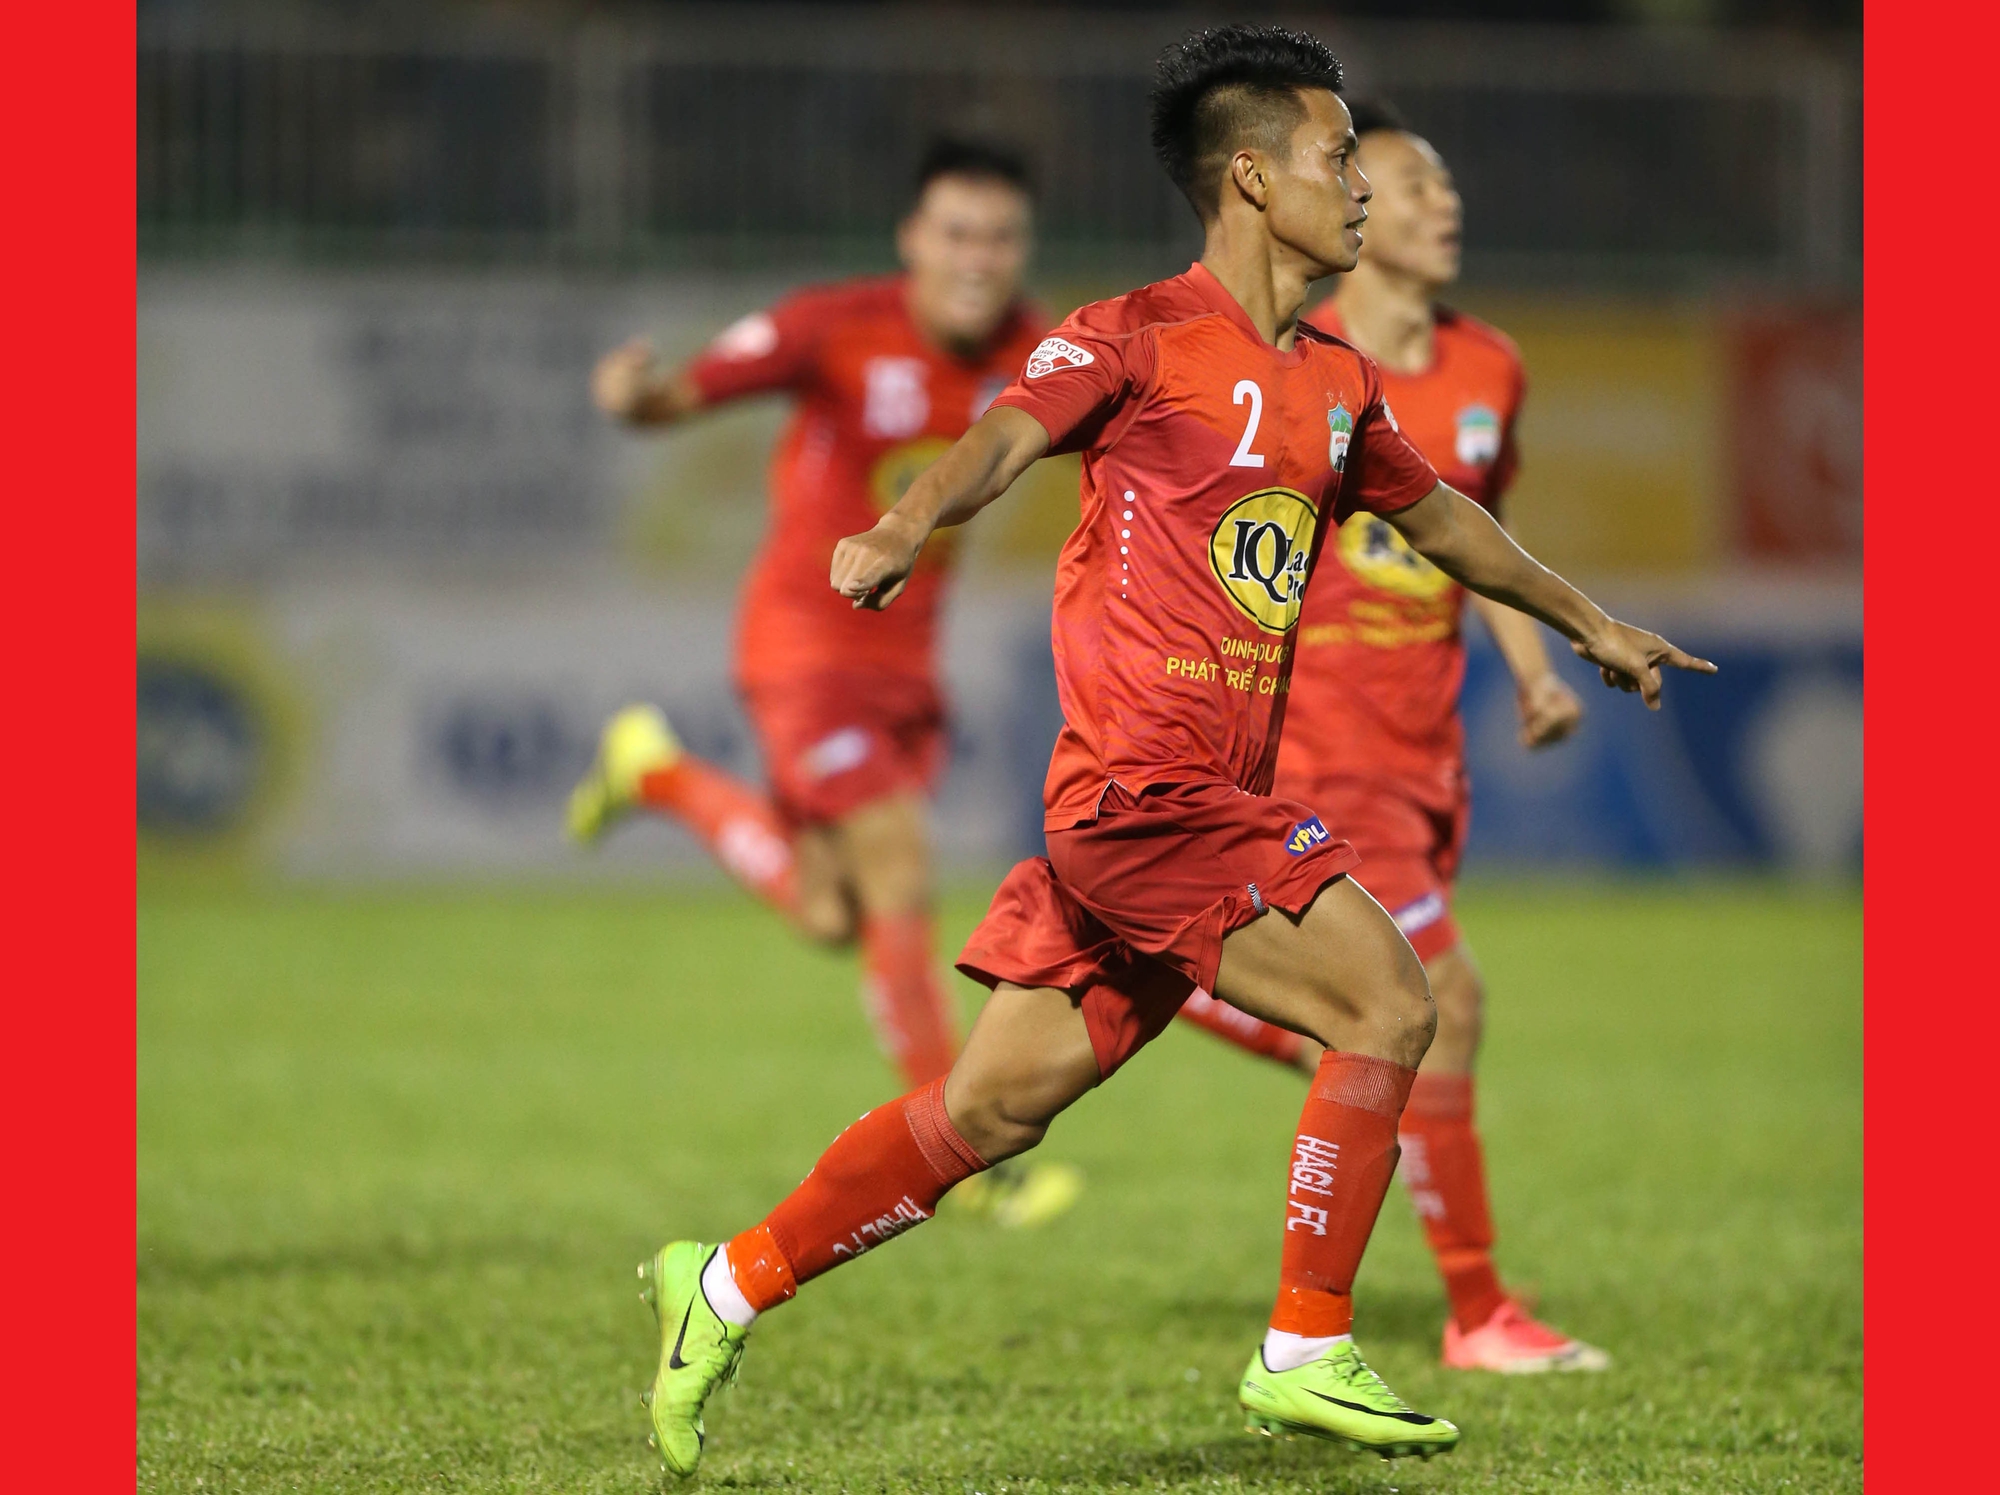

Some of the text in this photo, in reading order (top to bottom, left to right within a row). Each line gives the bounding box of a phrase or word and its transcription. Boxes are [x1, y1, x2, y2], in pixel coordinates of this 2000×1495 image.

[1040, 340, 1084, 363] OYOTA
[1228, 379, 1265, 468] 2
[1228, 520, 1289, 603] IQ
[1166, 656, 1221, 682] PHÁT
[1221, 636, 1261, 662] DINH
[1286, 1134, 1340, 1236] HAGL FC
